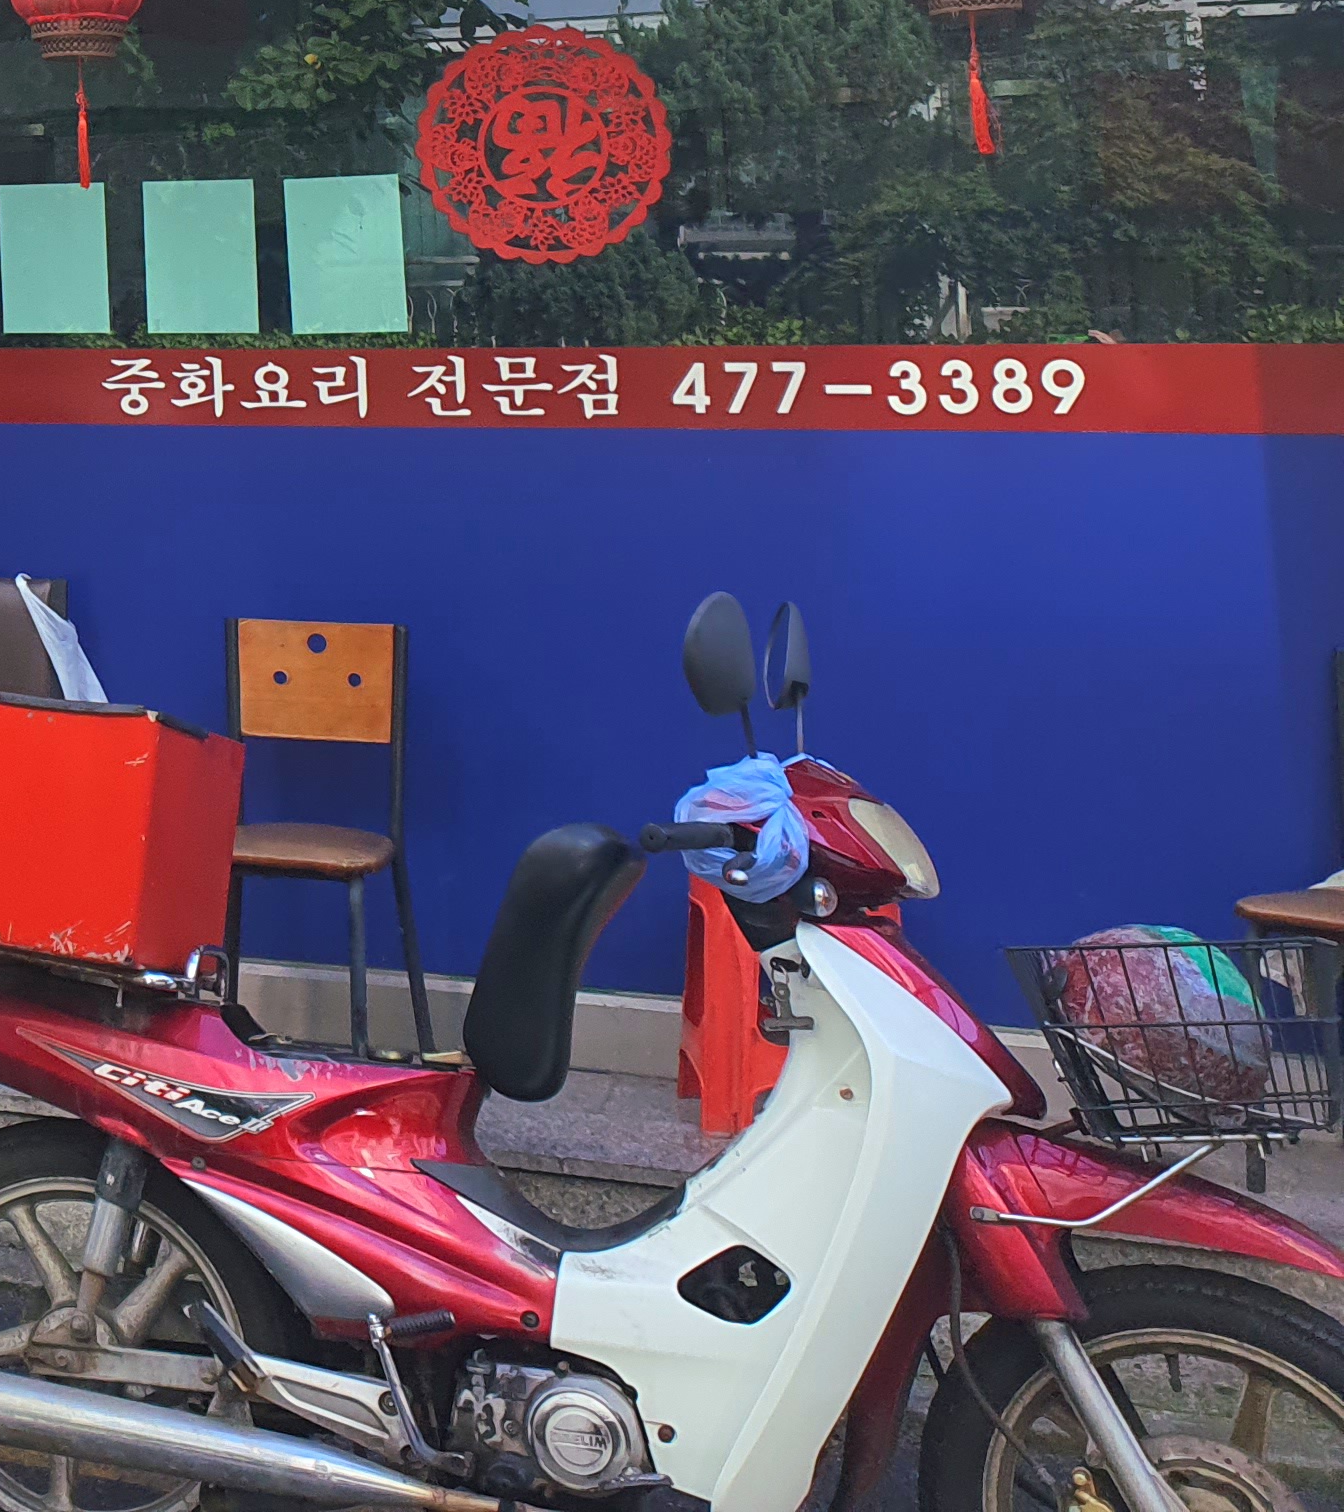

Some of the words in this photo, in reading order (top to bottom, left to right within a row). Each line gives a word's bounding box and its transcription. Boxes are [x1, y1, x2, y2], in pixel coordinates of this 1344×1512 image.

[102, 355, 369, 420] 중화요리
[406, 354, 621, 421] 전문점
[672, 358, 1088, 417] 477-3389
